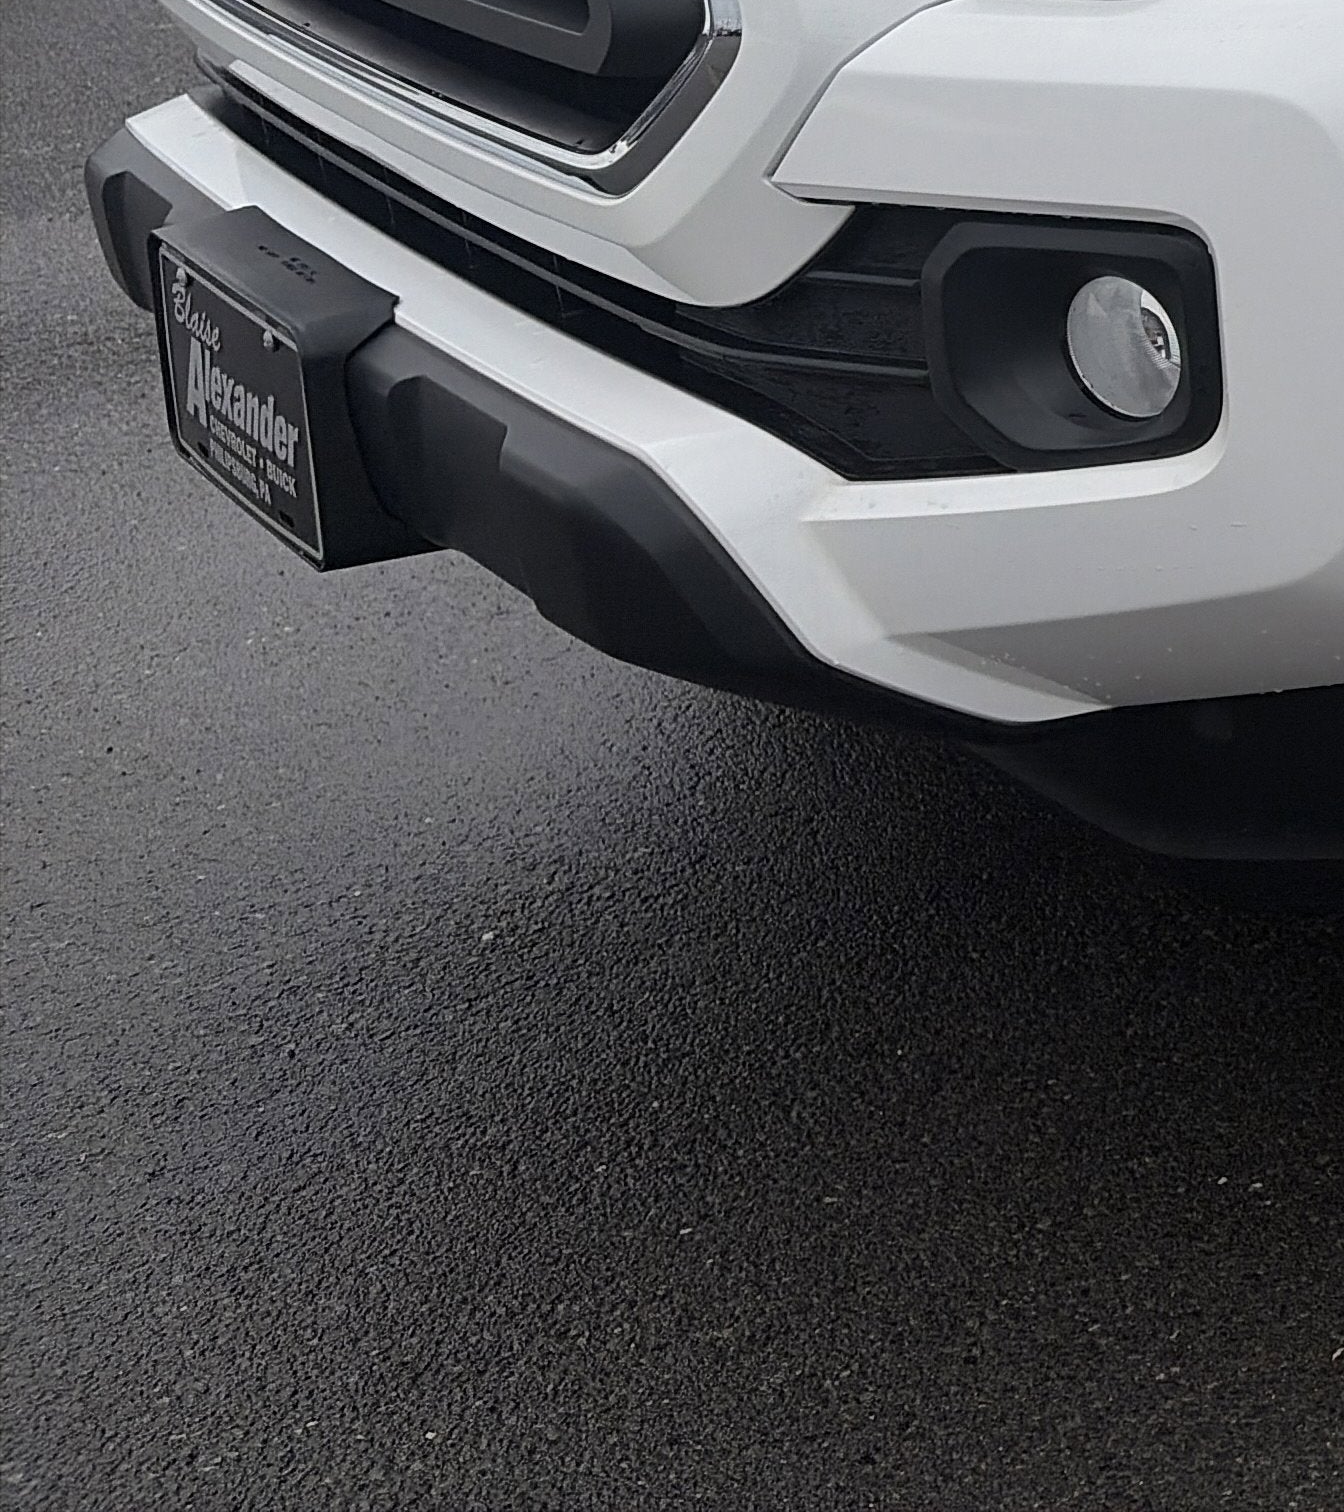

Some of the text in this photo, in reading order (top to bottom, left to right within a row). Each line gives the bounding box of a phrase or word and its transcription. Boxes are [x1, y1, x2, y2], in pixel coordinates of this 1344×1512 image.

[171, 282, 221, 352] Blaise
[186, 335, 299, 468] Alexander
[209, 414, 297, 498] CHEVROLET BUICK
